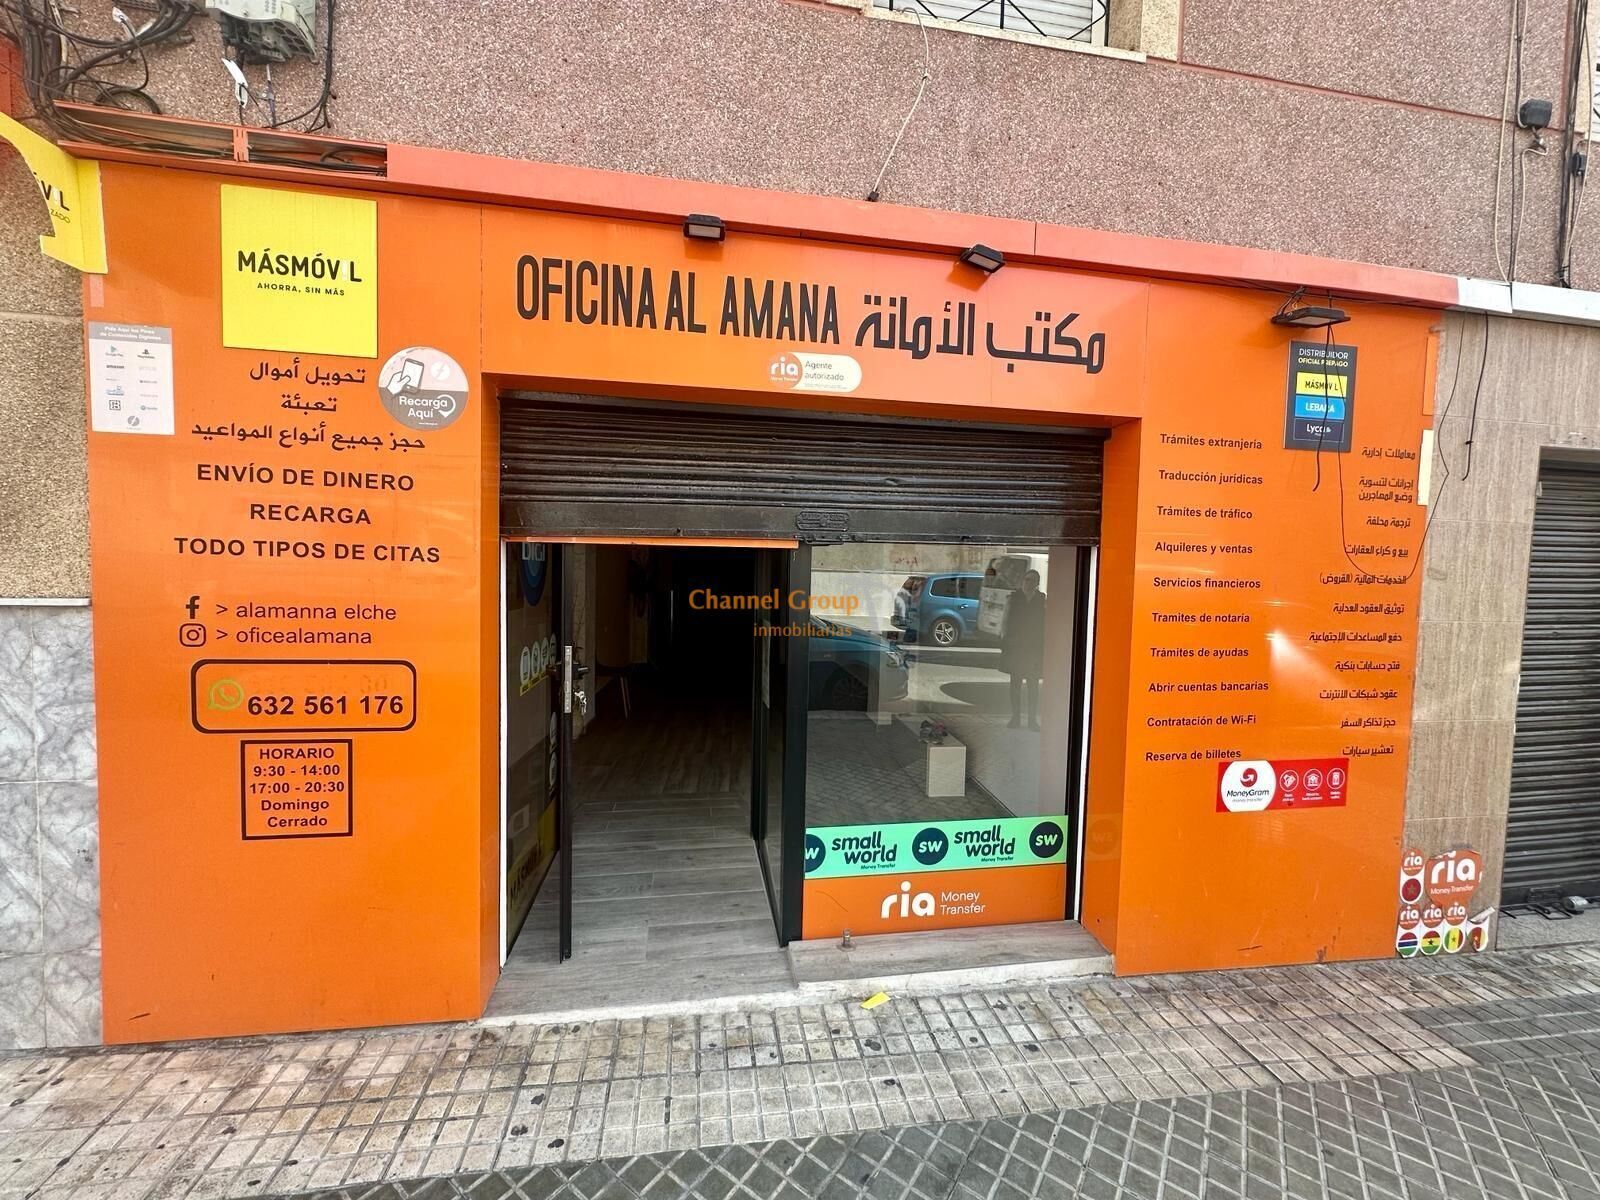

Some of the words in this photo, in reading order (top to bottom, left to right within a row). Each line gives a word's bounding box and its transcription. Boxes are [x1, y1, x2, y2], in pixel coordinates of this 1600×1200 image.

[257, 282, 301, 293] AHORRA,
[305, 286, 321, 294] SIN
[325, 286, 345, 296] MÁS
[516, 254, 657, 330] OFICINA
[664, 270, 707, 334] AL
[719, 275, 840, 345] AMANA
[854, 294, 976, 360] الأمانة
[986, 310, 1106, 375] مكتب
[250, 357, 299, 380] أموال
[770, 356, 799, 376] ria
[805, 360, 833, 370] Agente
[305, 366, 366, 386] تحويل
[804, 372, 845, 381] autorizado
[280, 393, 337, 416] تعبئة
[398, 396, 448, 410] Recarga
[407, 408, 434, 420] Aquí
[191, 422, 273, 442] المواعيد
[279, 421, 326, 448] أنواع
[1160, 433, 1205, 446] Trámites
[331, 433, 384, 451] جميع
[389, 432, 426, 453] حجز
[197, 463, 274, 484] ENVÍO
[283, 469, 314, 486] DE
[323, 471, 415, 491] DINERO
[1159, 469, 1217, 482] Traducción
[250, 503, 372, 525] RECARGA
[1157, 505, 1202, 517] Trámites
[1204, 507, 1218, 518] de
[1220, 508, 1253, 519] tráfico
[174, 537, 245, 556] TODO
[253, 540, 326, 559] TIPOS
[334, 543, 365, 560] DE
[373, 545, 440, 563] CITAS
[1155, 541, 1208, 554] Alquileres
[1210, 545, 1217, 555] y
[1219, 544, 1253, 554] ventas
[1153, 576, 1202, 588] Servicios
[1204, 577, 1261, 588] financieros
[235, 602, 337, 619] alamanna
[344, 603, 397, 620] elche
[1199, 613, 1212, 623] de
[236, 627, 372, 644] oficealamana
[1150, 647, 1194, 657] Trámites
[1197, 647, 1210, 657] de
[1212, 647, 1249, 659] ayudas
[1148, 682, 1175, 692] Abrir
[1177, 682, 1217, 692] cuentas
[1220, 681, 1269, 691] bancarias
[247, 695, 294, 715] 632
[304, 695, 347, 715] 561
[359, 695, 404, 715] 176
[1147, 716, 1212, 727] Contratación
[1216, 715, 1228, 725] de
[1231, 714, 1256, 724] Wi-Fi
[259, 747, 335, 760] HORARIO
[1145, 751, 1187, 762] Reserva
[1190, 750, 1203, 760] de
[1205, 749, 1242, 760] billetes
[253, 765, 286, 777] 9:30
[300, 764, 341, 776] 14:00
[250, 782, 290, 794] 17:00
[304, 781, 345, 793] 20:30
[1226, 789, 1270, 798] MoneyGram
[261, 798, 330, 812] Domingo
[267, 815, 328, 828] Cerrado
[831, 830, 882, 851] small
[954, 825, 1001, 844] small
[843, 844, 898, 865] world
[965, 837, 1016, 858] world
[1404, 851, 1422, 866] ria
[1431, 852, 1476, 884] ria
[940, 891, 980, 904] Money
[1430, 887, 1451, 895] Money
[880, 880, 936, 919] ria
[940, 902, 986, 916] Transfer
[1400, 905, 1419, 920] ria
[1423, 903, 1442, 919] ria
[1447, 902, 1466, 916] ria
